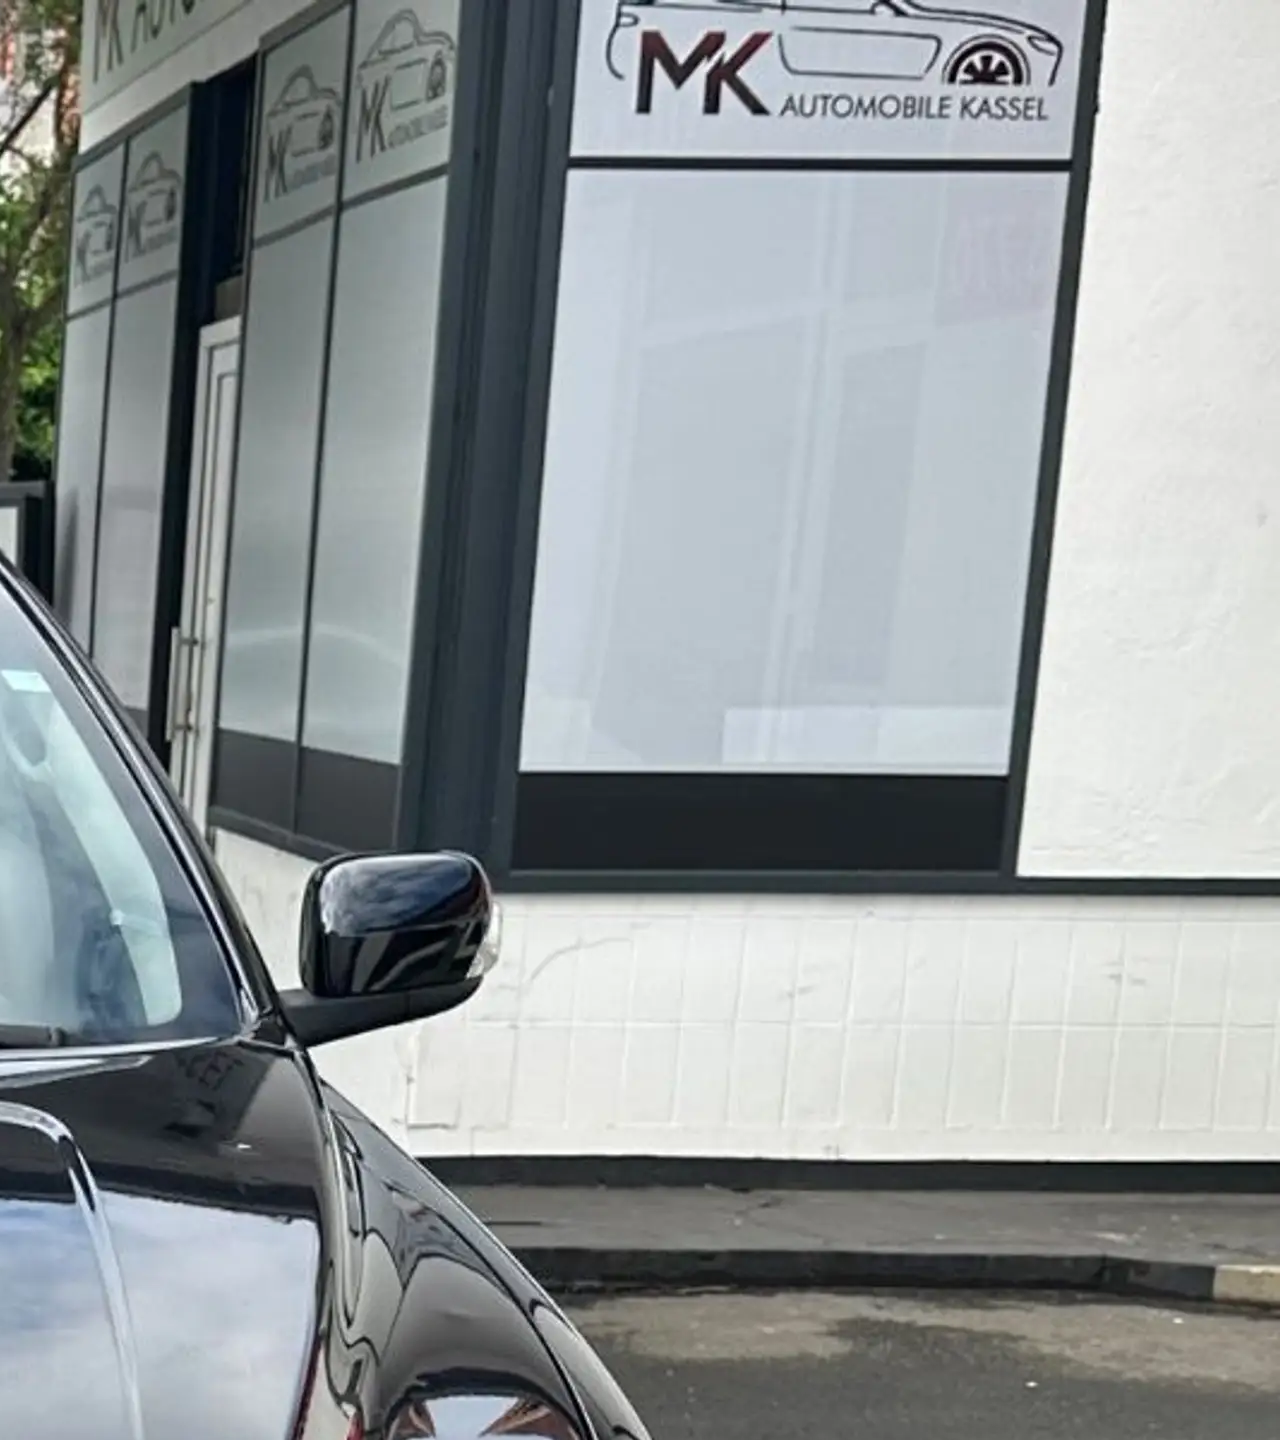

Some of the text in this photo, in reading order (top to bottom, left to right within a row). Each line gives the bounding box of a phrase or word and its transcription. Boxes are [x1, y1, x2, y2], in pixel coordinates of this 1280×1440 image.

[636, 31, 774, 115] MK
[780, 93, 1049, 120] AUTOMOBILE KASSEL
